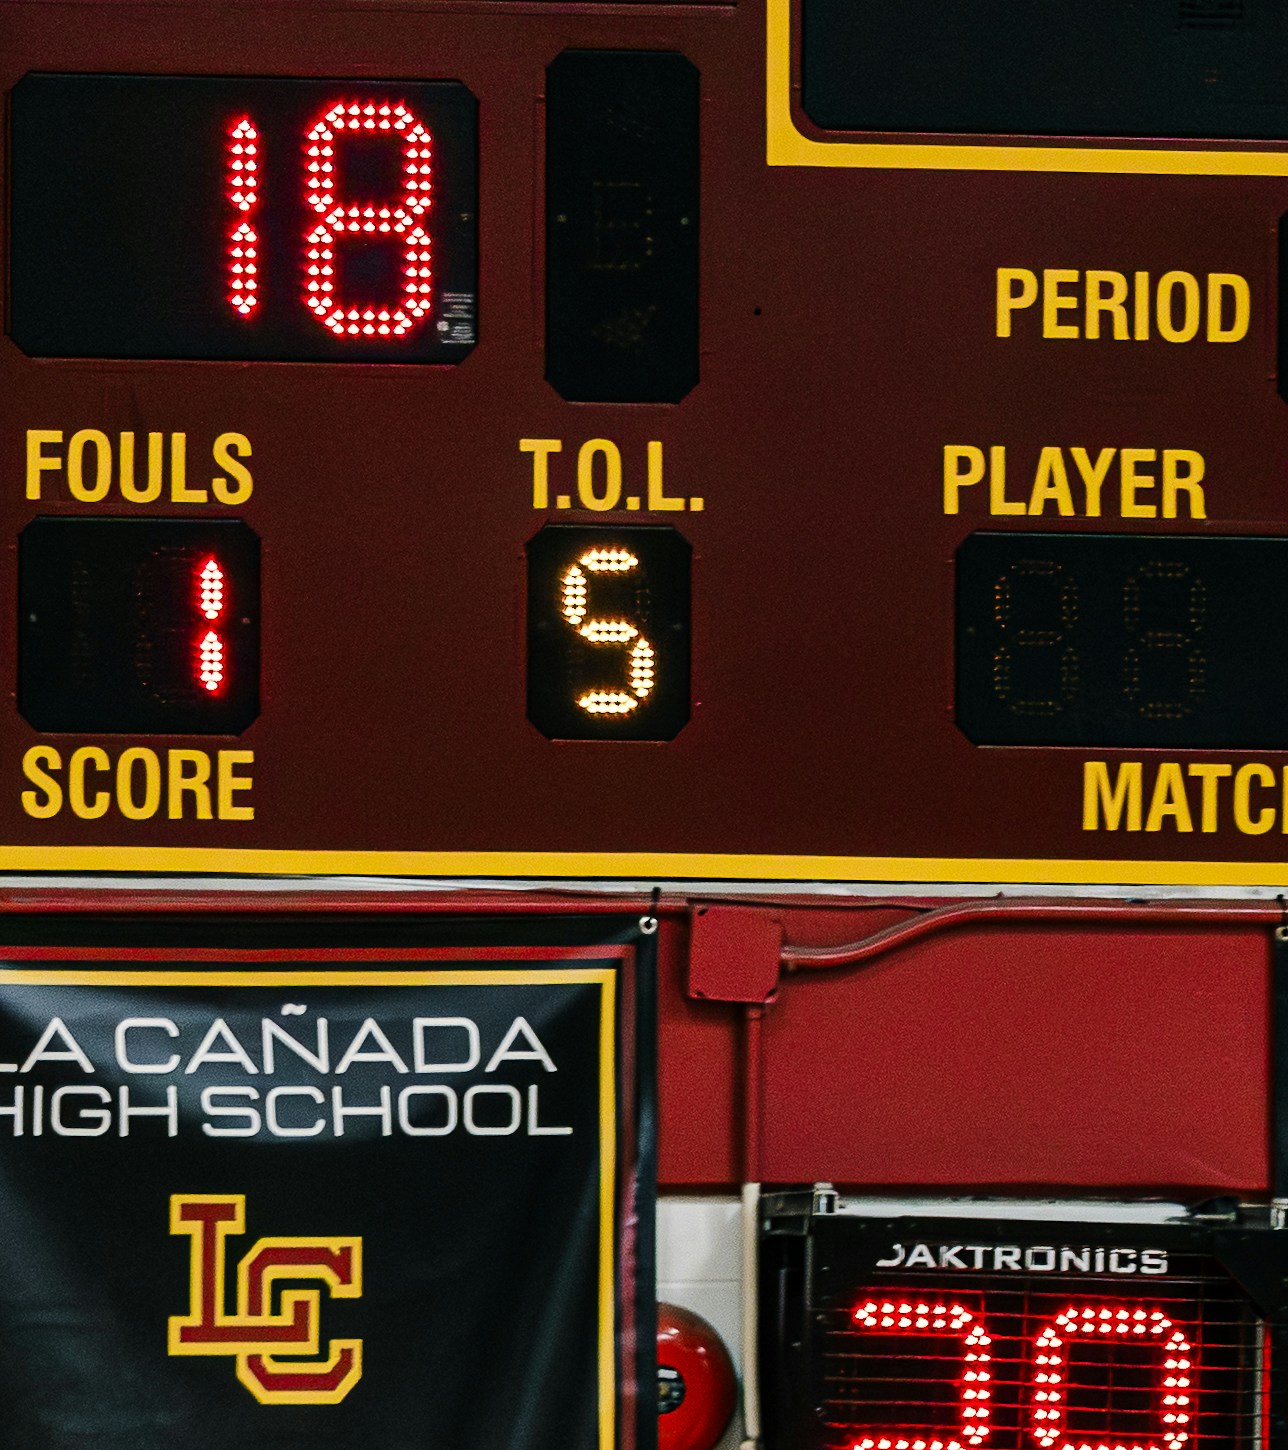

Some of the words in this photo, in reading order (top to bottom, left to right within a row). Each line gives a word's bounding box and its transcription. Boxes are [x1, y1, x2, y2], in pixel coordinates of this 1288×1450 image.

[224, 96, 435, 341] 18
[995, 267, 1251, 343] PERIOD
[25, 428, 254, 506] FOULS
[518, 438, 705, 512] T.O.L.
[943, 444, 1207, 520] PLAYER
[191, 553, 229, 697] 1
[559, 545, 655, 719] 5
[21, 745, 255, 821] SCORE
[114, 1003, 558, 1075] CAÑADA
[199, 1084, 573, 1138] SCHOOL
